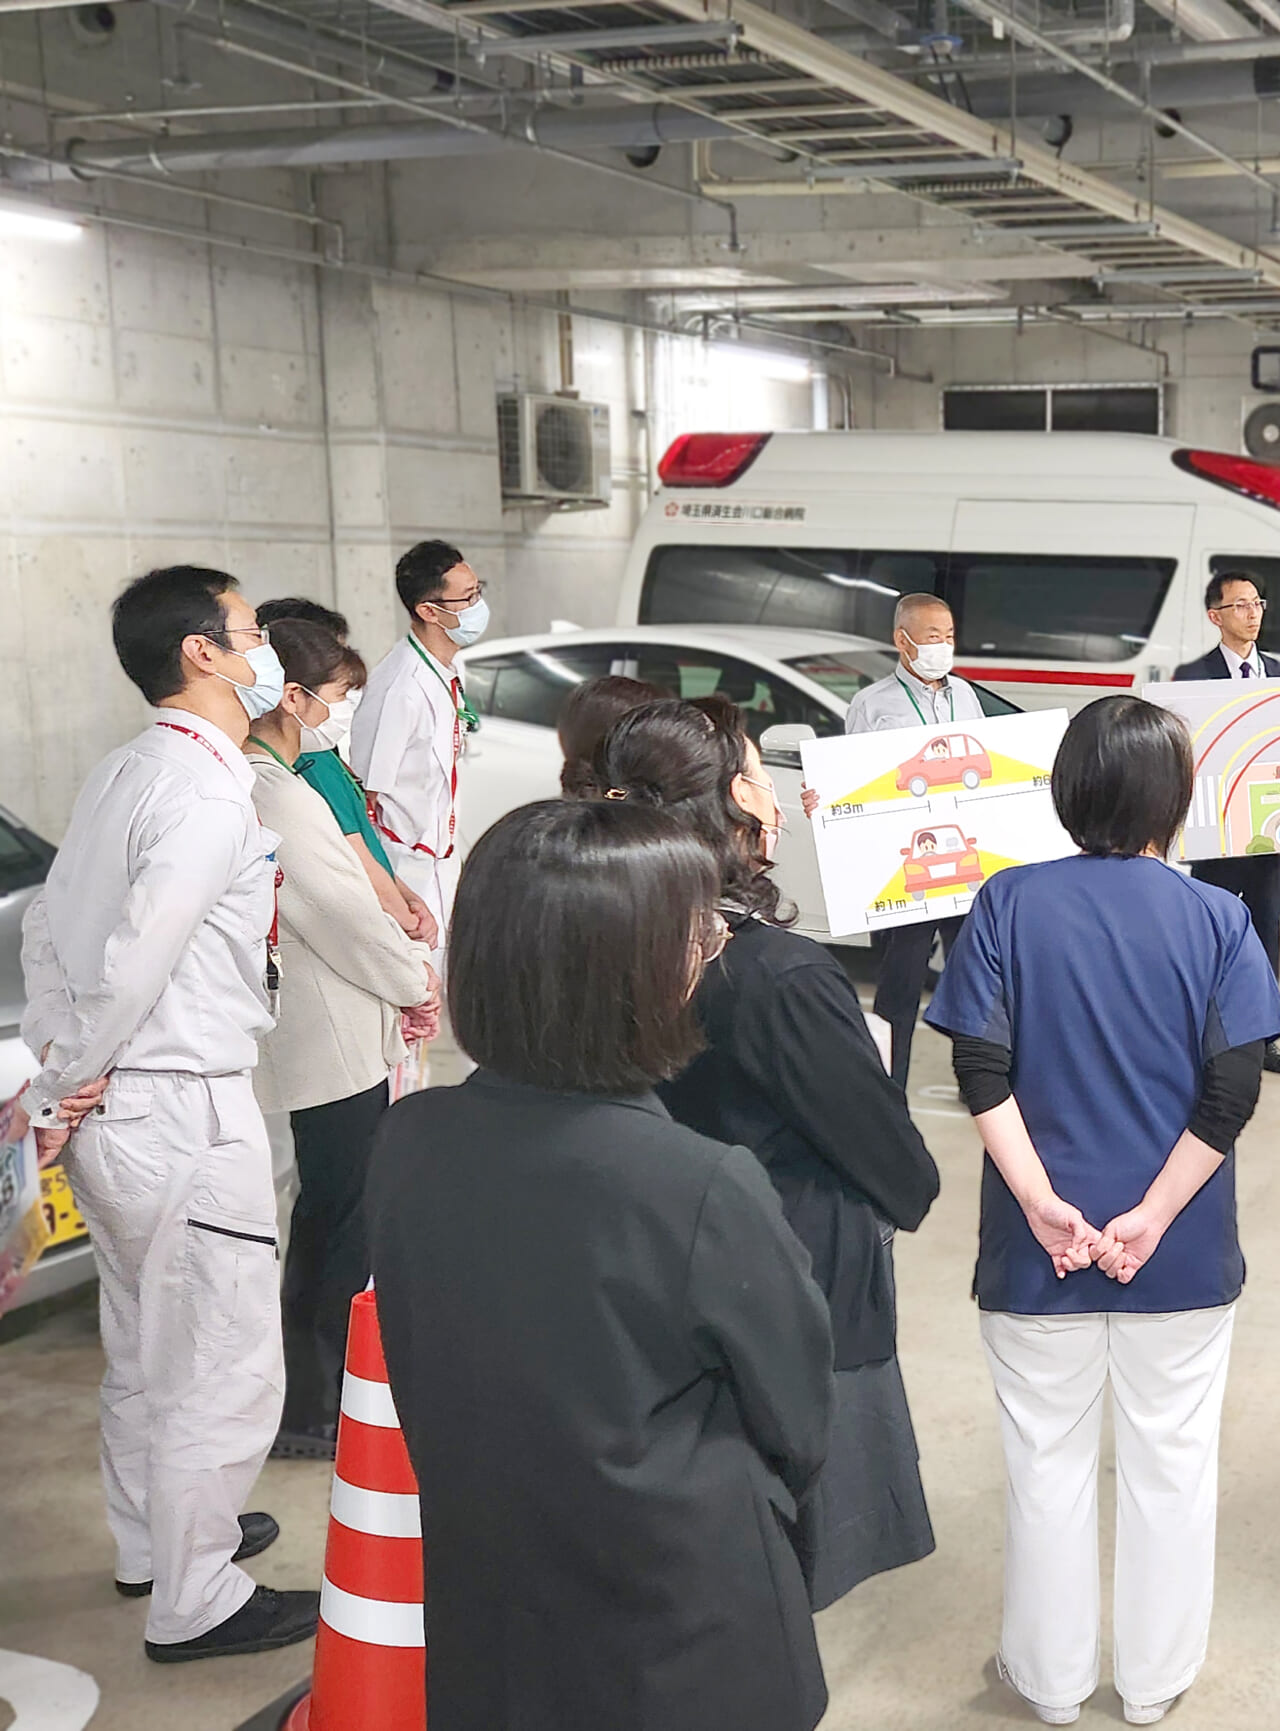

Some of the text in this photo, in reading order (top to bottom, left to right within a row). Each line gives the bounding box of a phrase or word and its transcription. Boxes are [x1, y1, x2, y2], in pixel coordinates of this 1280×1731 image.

[681, 504, 806, 521] 埼玉県済生会川口総合病院
[831, 801, 864, 816] 約3m
[874, 897, 907, 912] 約1m
